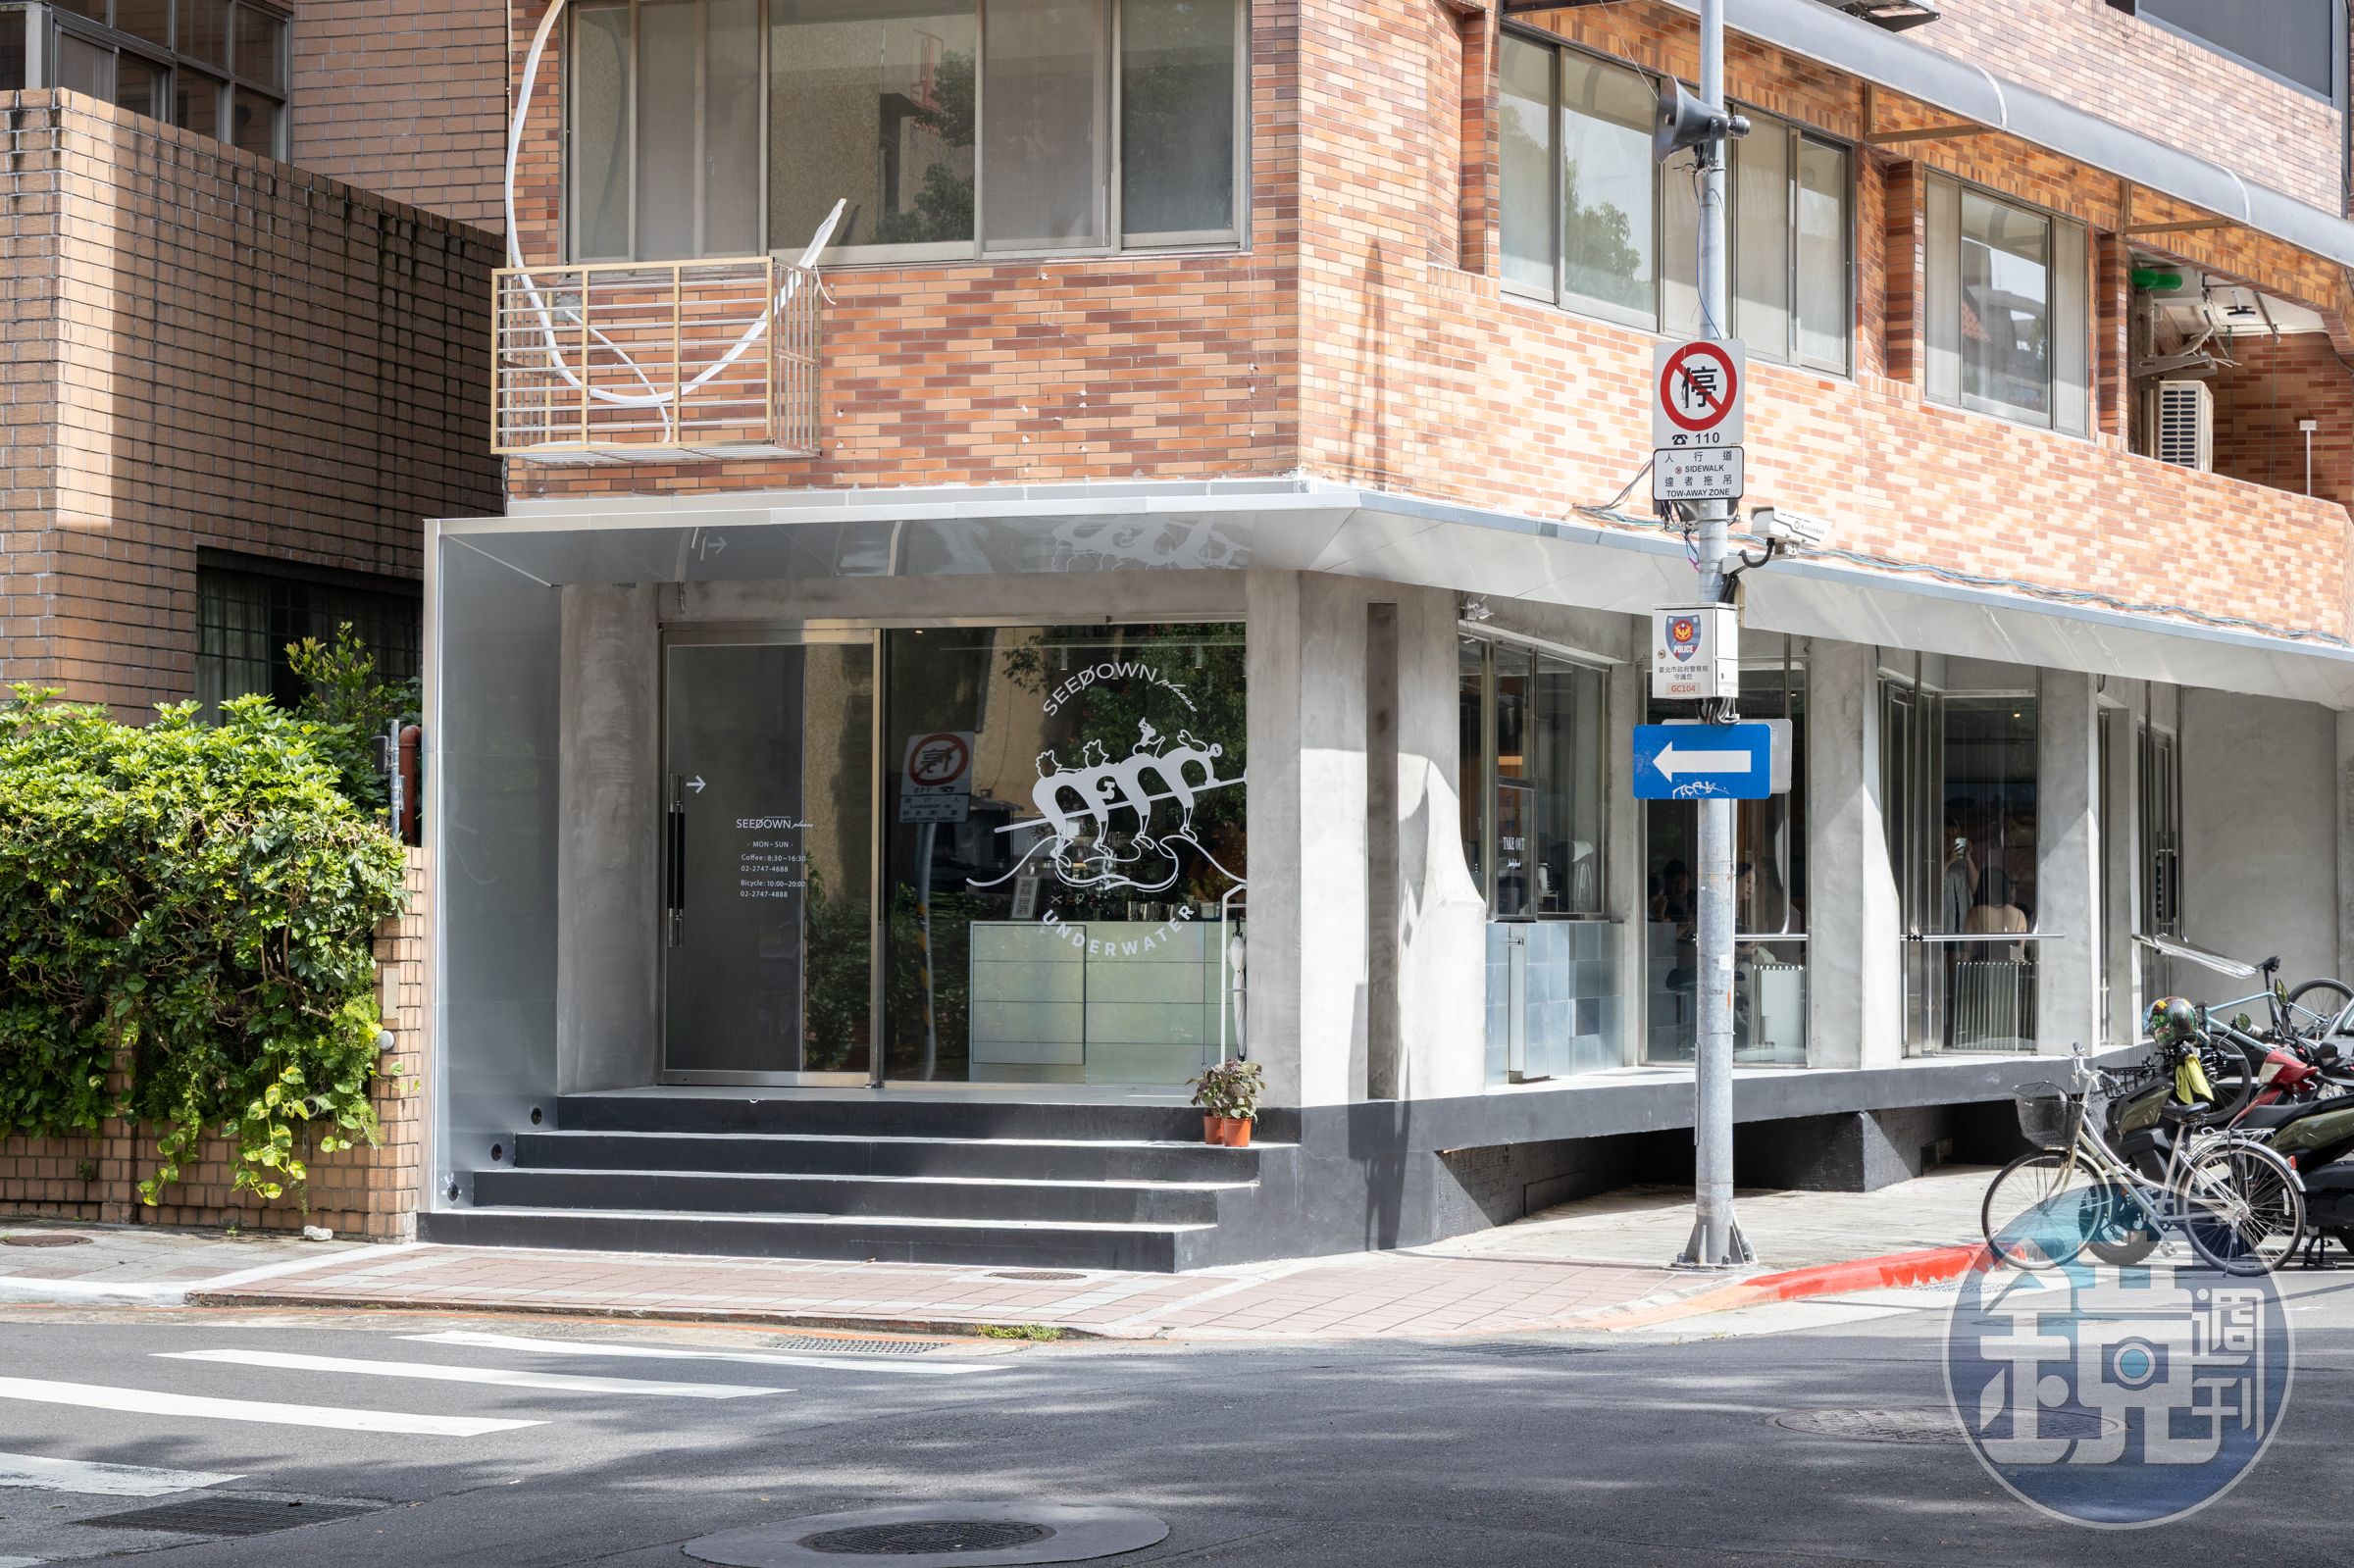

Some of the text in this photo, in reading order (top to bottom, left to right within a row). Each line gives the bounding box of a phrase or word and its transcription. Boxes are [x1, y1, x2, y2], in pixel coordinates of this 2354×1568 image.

[1681, 366, 1718, 409] 停
[1694, 432, 1720, 444] 110
[1663, 450, 1732, 464] 人行道
[1684, 464, 1724, 473] SIDEWALK
[1664, 474, 1732, 487] 違者拖吊
[1666, 488, 1730, 498] TOW-AWAY ZONE
[1673, 644, 1694, 654] POLICE
[1670, 684, 1696, 693] GC104
[1042, 903, 1196, 957] UNDERWATER
